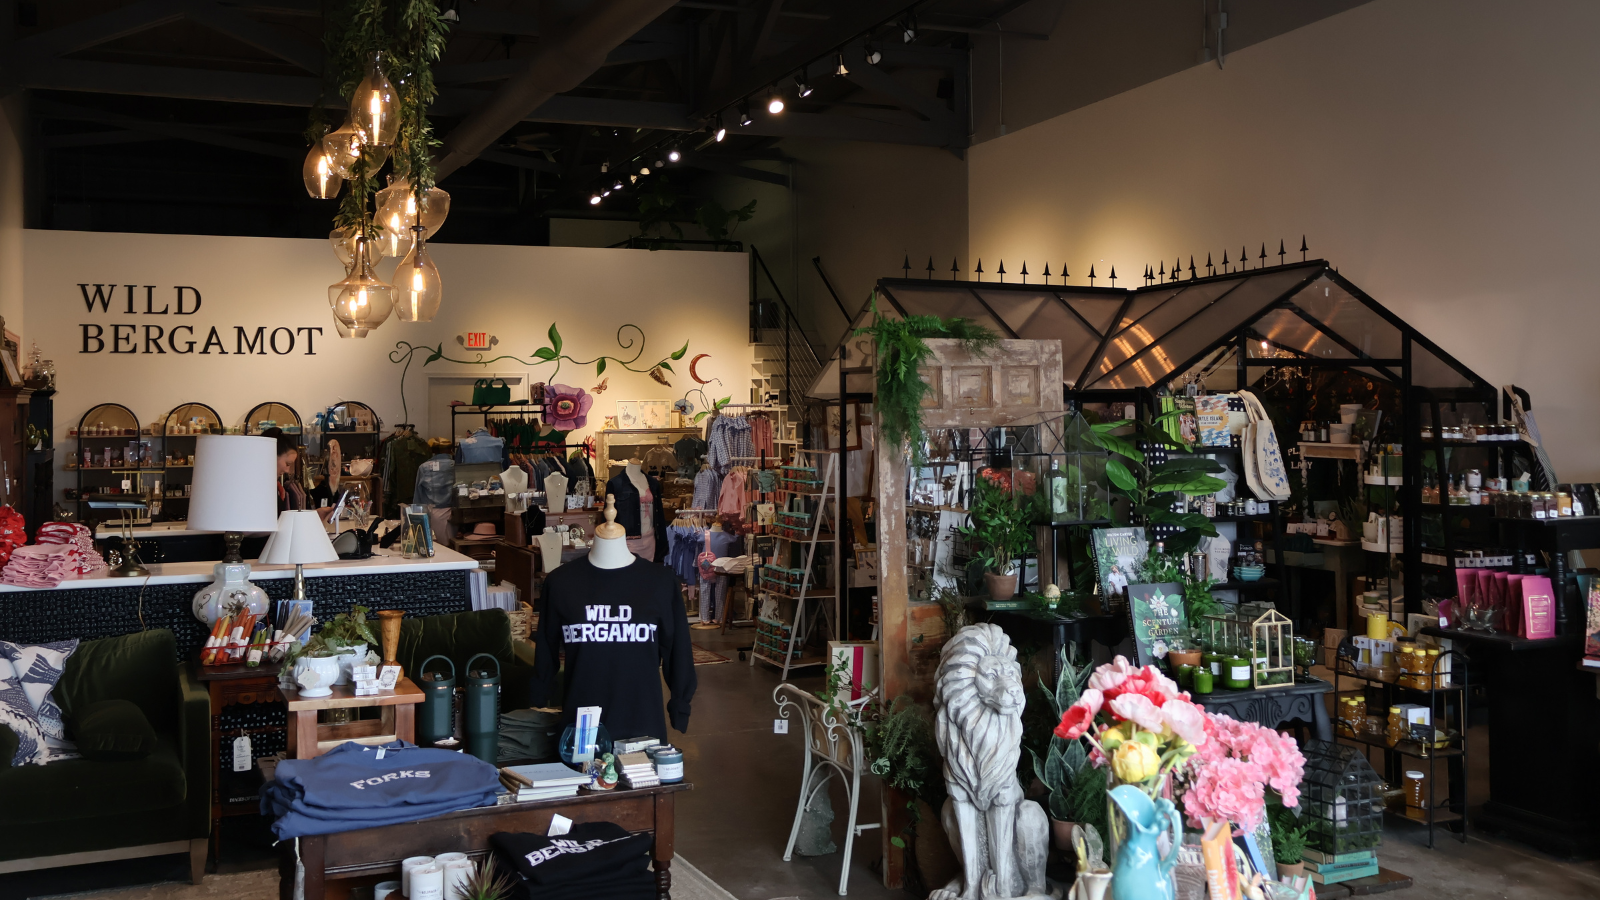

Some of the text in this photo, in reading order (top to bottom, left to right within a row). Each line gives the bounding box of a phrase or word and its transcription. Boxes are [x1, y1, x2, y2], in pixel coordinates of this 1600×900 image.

[77, 283, 202, 315] WILD
[79, 323, 324, 356] BERGAMOT
[467, 332, 487, 347] EXIT
[1290, 461, 1313, 470] LAY
[1104, 536, 1137, 547] LIVING
[1111, 545, 1139, 556] WILD
[585, 604, 632, 622] WILD
[1152, 608, 1169, 617] THE
[562, 623, 658, 643] BERGAMOT
[1148, 627, 1179, 637] GARDEN
[350, 770, 431, 789] FORKS
